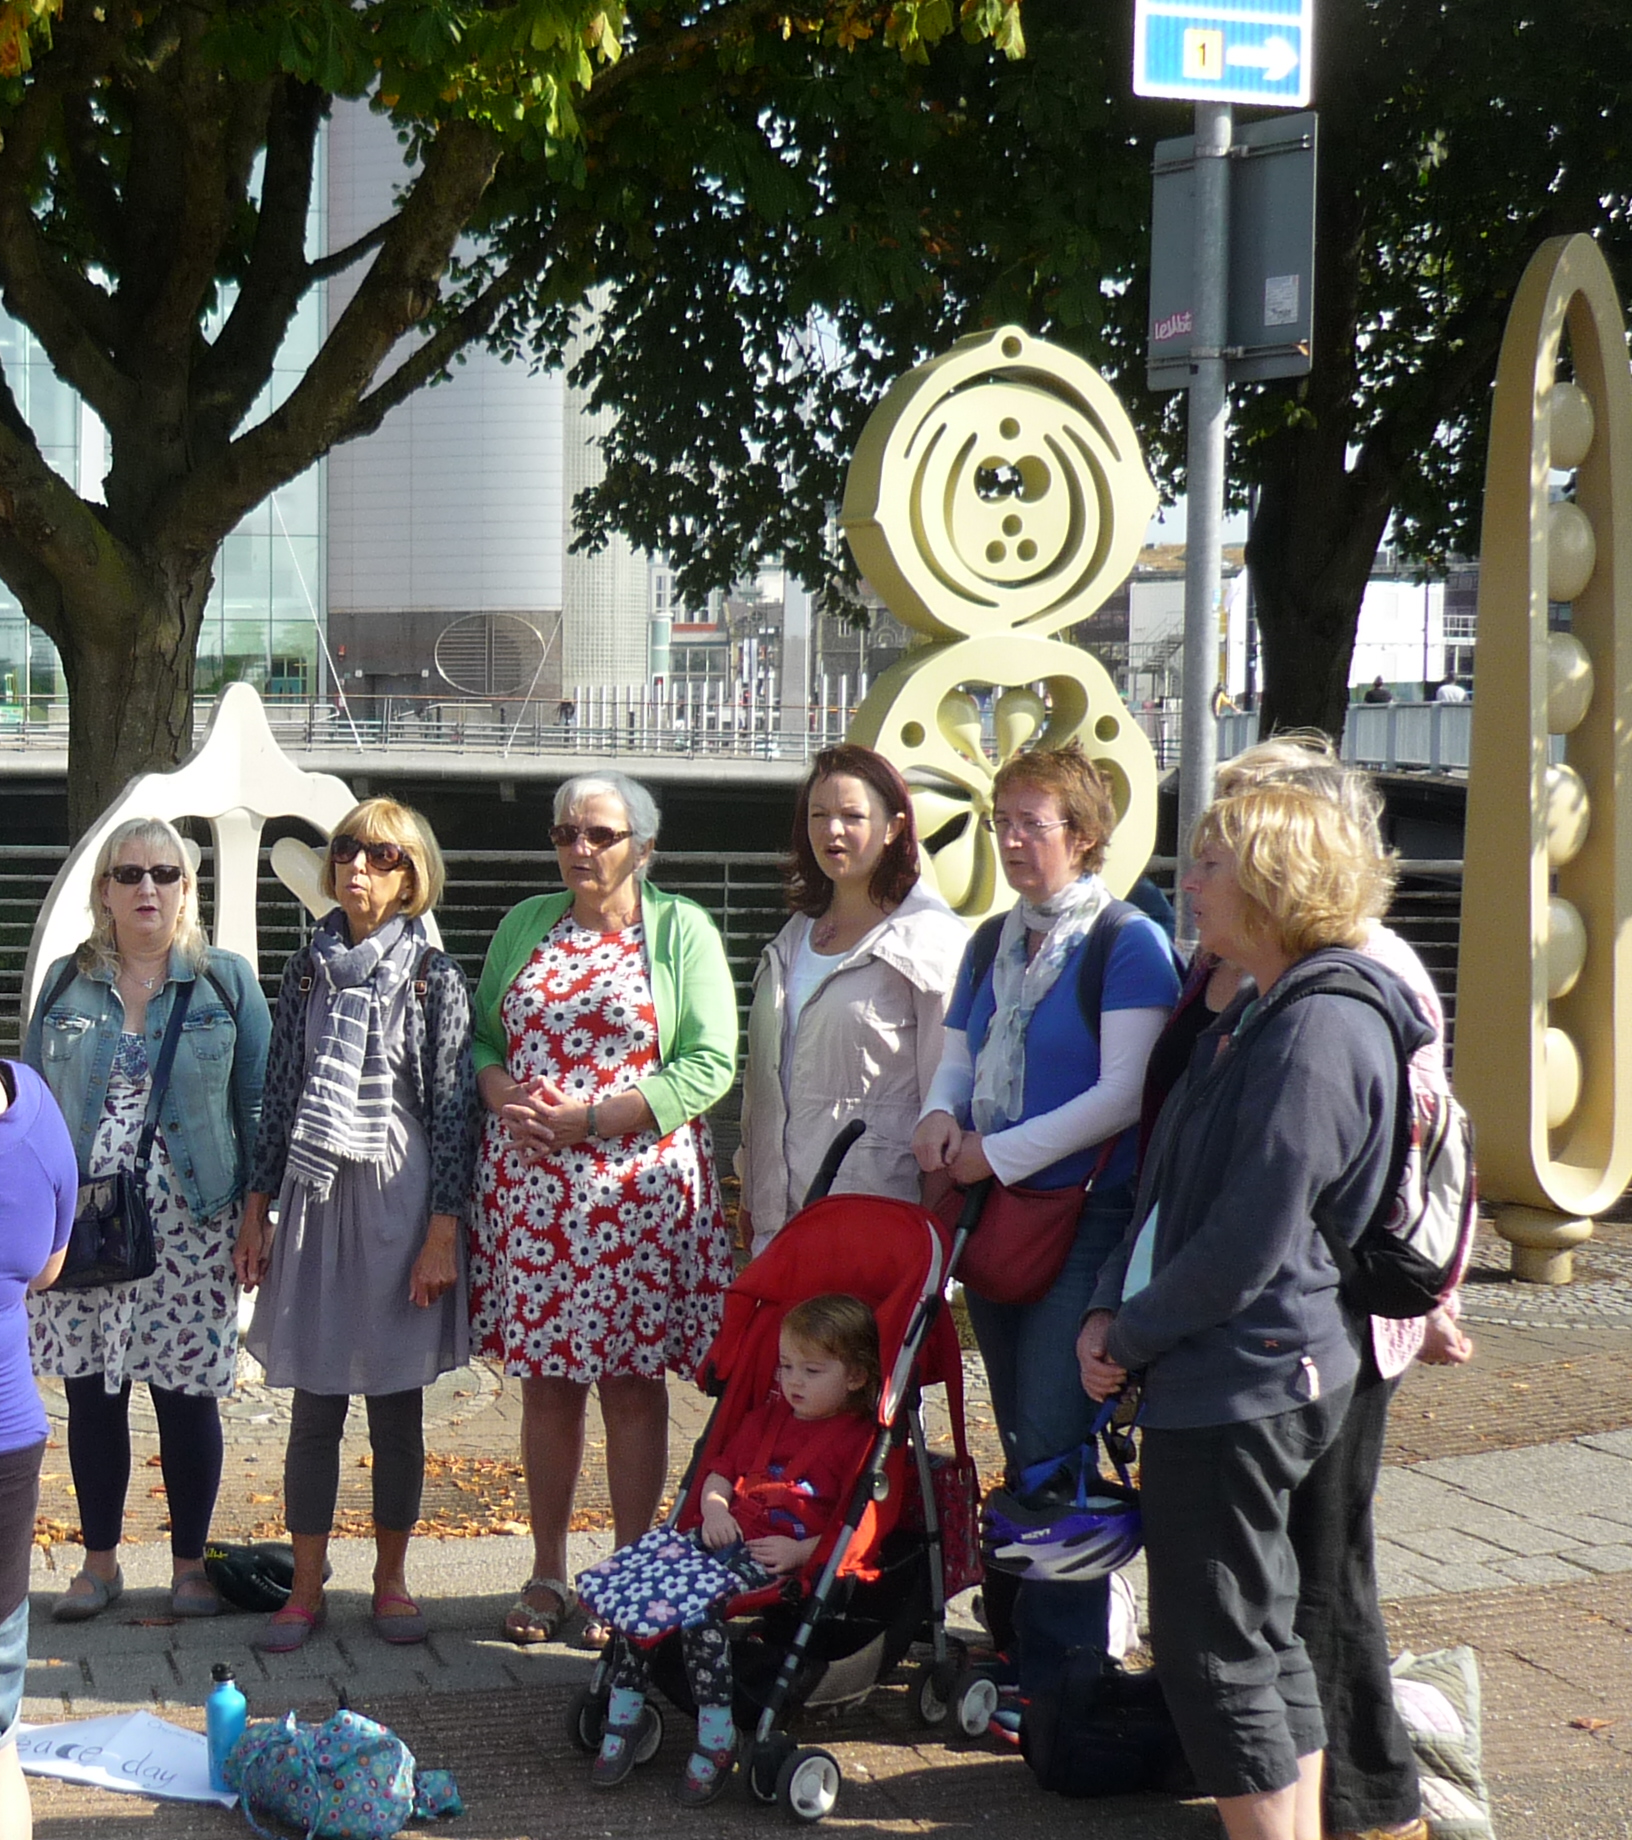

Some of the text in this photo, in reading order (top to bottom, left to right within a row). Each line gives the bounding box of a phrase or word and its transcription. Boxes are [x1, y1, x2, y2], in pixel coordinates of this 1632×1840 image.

[1197, 42, 1206, 66] 1
[17, 1734, 180, 1788] eace day
